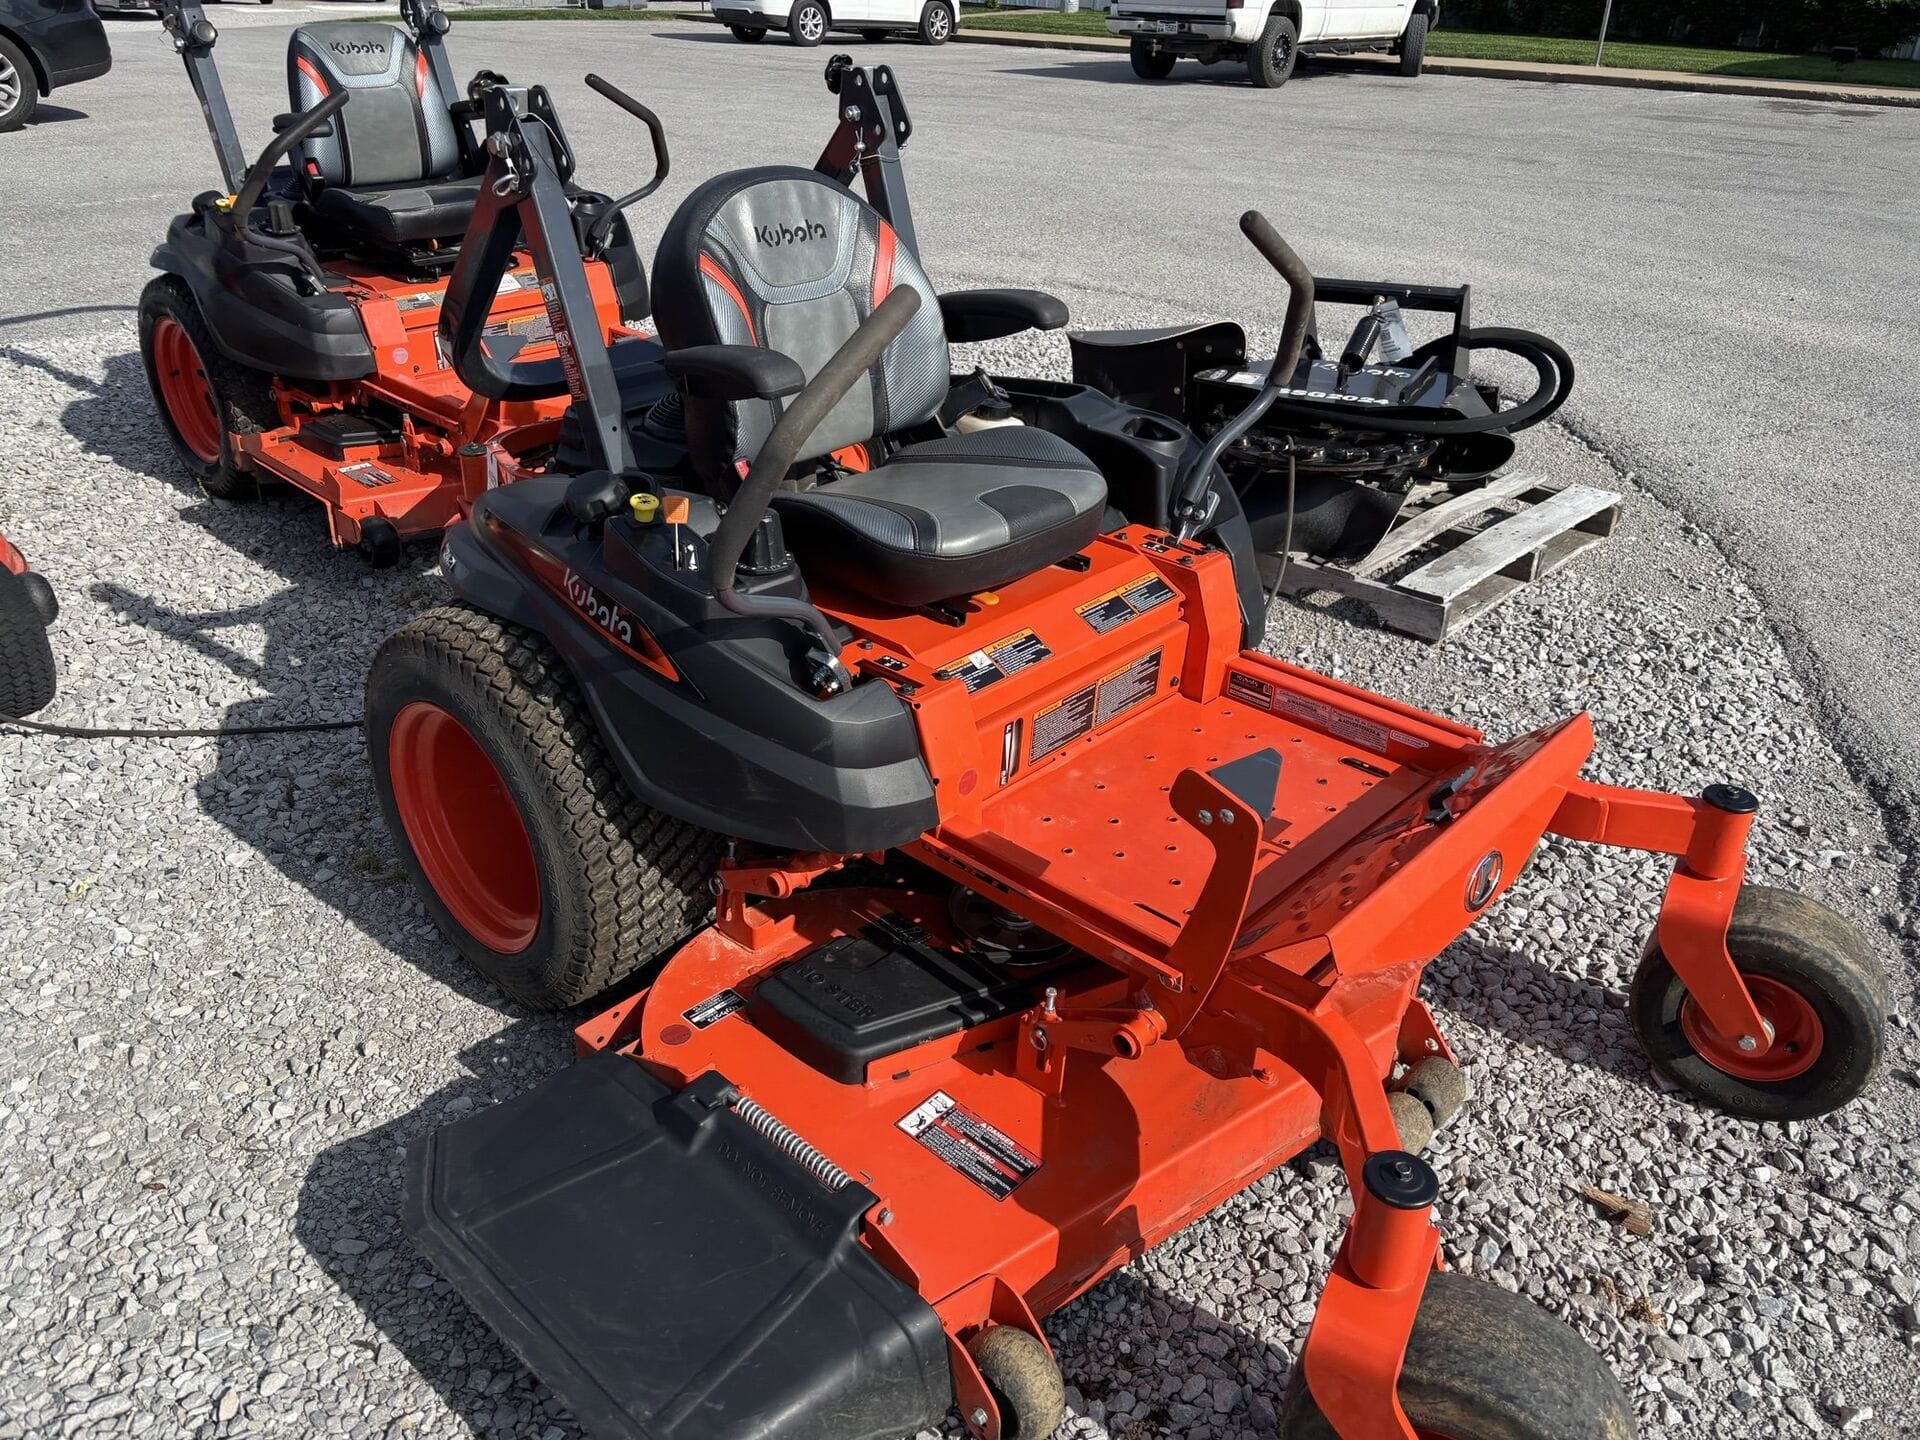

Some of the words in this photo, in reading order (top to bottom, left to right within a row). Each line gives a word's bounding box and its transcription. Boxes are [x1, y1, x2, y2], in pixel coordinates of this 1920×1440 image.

[330, 41, 385, 54] Kubota
[754, 219, 827, 247] Kubota
[563, 567, 632, 643] Kubota
[825, 984, 878, 1017] STEP
[984, 1124, 1016, 1147] DANGER
[965, 1141, 996, 1165] PELIGRO
